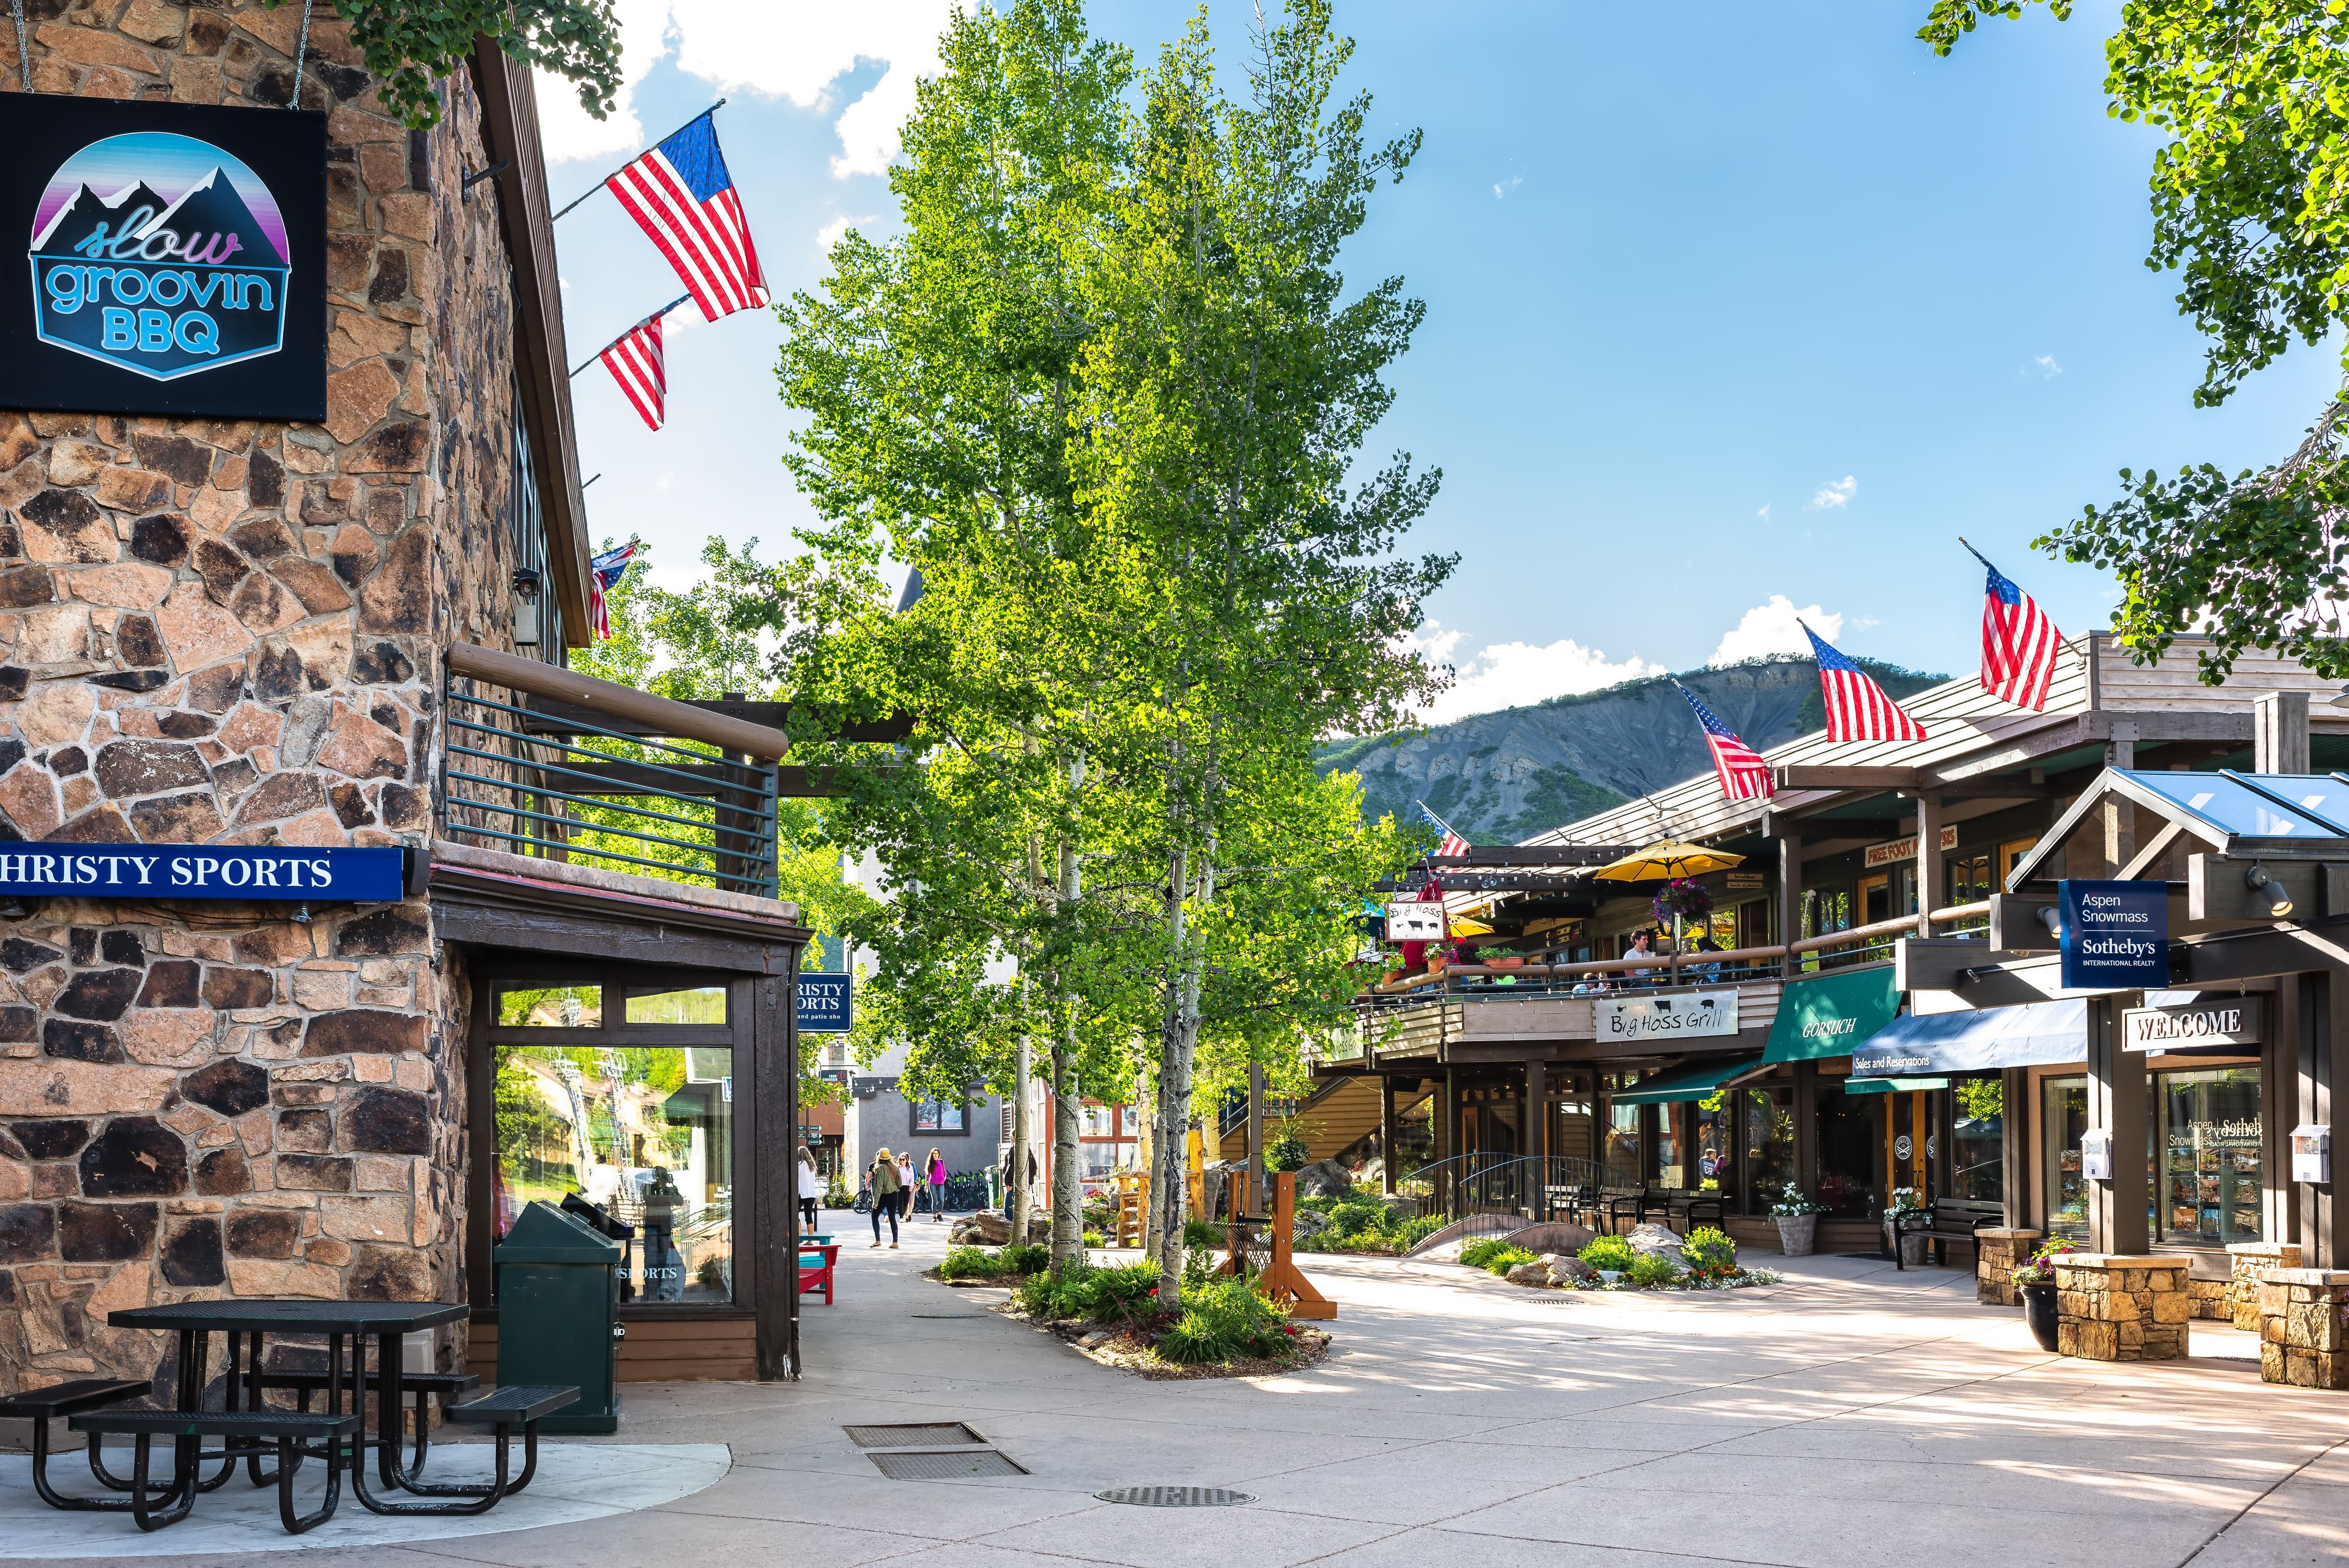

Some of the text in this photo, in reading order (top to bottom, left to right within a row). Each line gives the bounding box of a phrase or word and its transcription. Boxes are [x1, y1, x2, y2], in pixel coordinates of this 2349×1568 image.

[75, 205, 243, 264] slow
[46, 264, 273, 314] groovin
[102, 307, 220, 355] BBQ
[1868, 846, 1888, 864] FREE
[1888, 840, 1911, 860] FOOT
[171, 857, 332, 888] SPORTS
[2082, 894, 2120, 908] Aspen
[2082, 910, 2148, 922] Snowmass
[2083, 938, 2155, 958] Sotheby's
[1611, 1015, 1637, 1037] Big
[1686, 1009, 1722, 1029] Grill
[1803, 1018, 1857, 1038] GORSUCH
[2139, 1009, 2241, 1041] WELCOME
[1855, 1055, 1930, 1069] Sales and Reservations
[2188, 1118, 2213, 1132] Aspen
[620, 1268, 677, 1279] SPORTS
